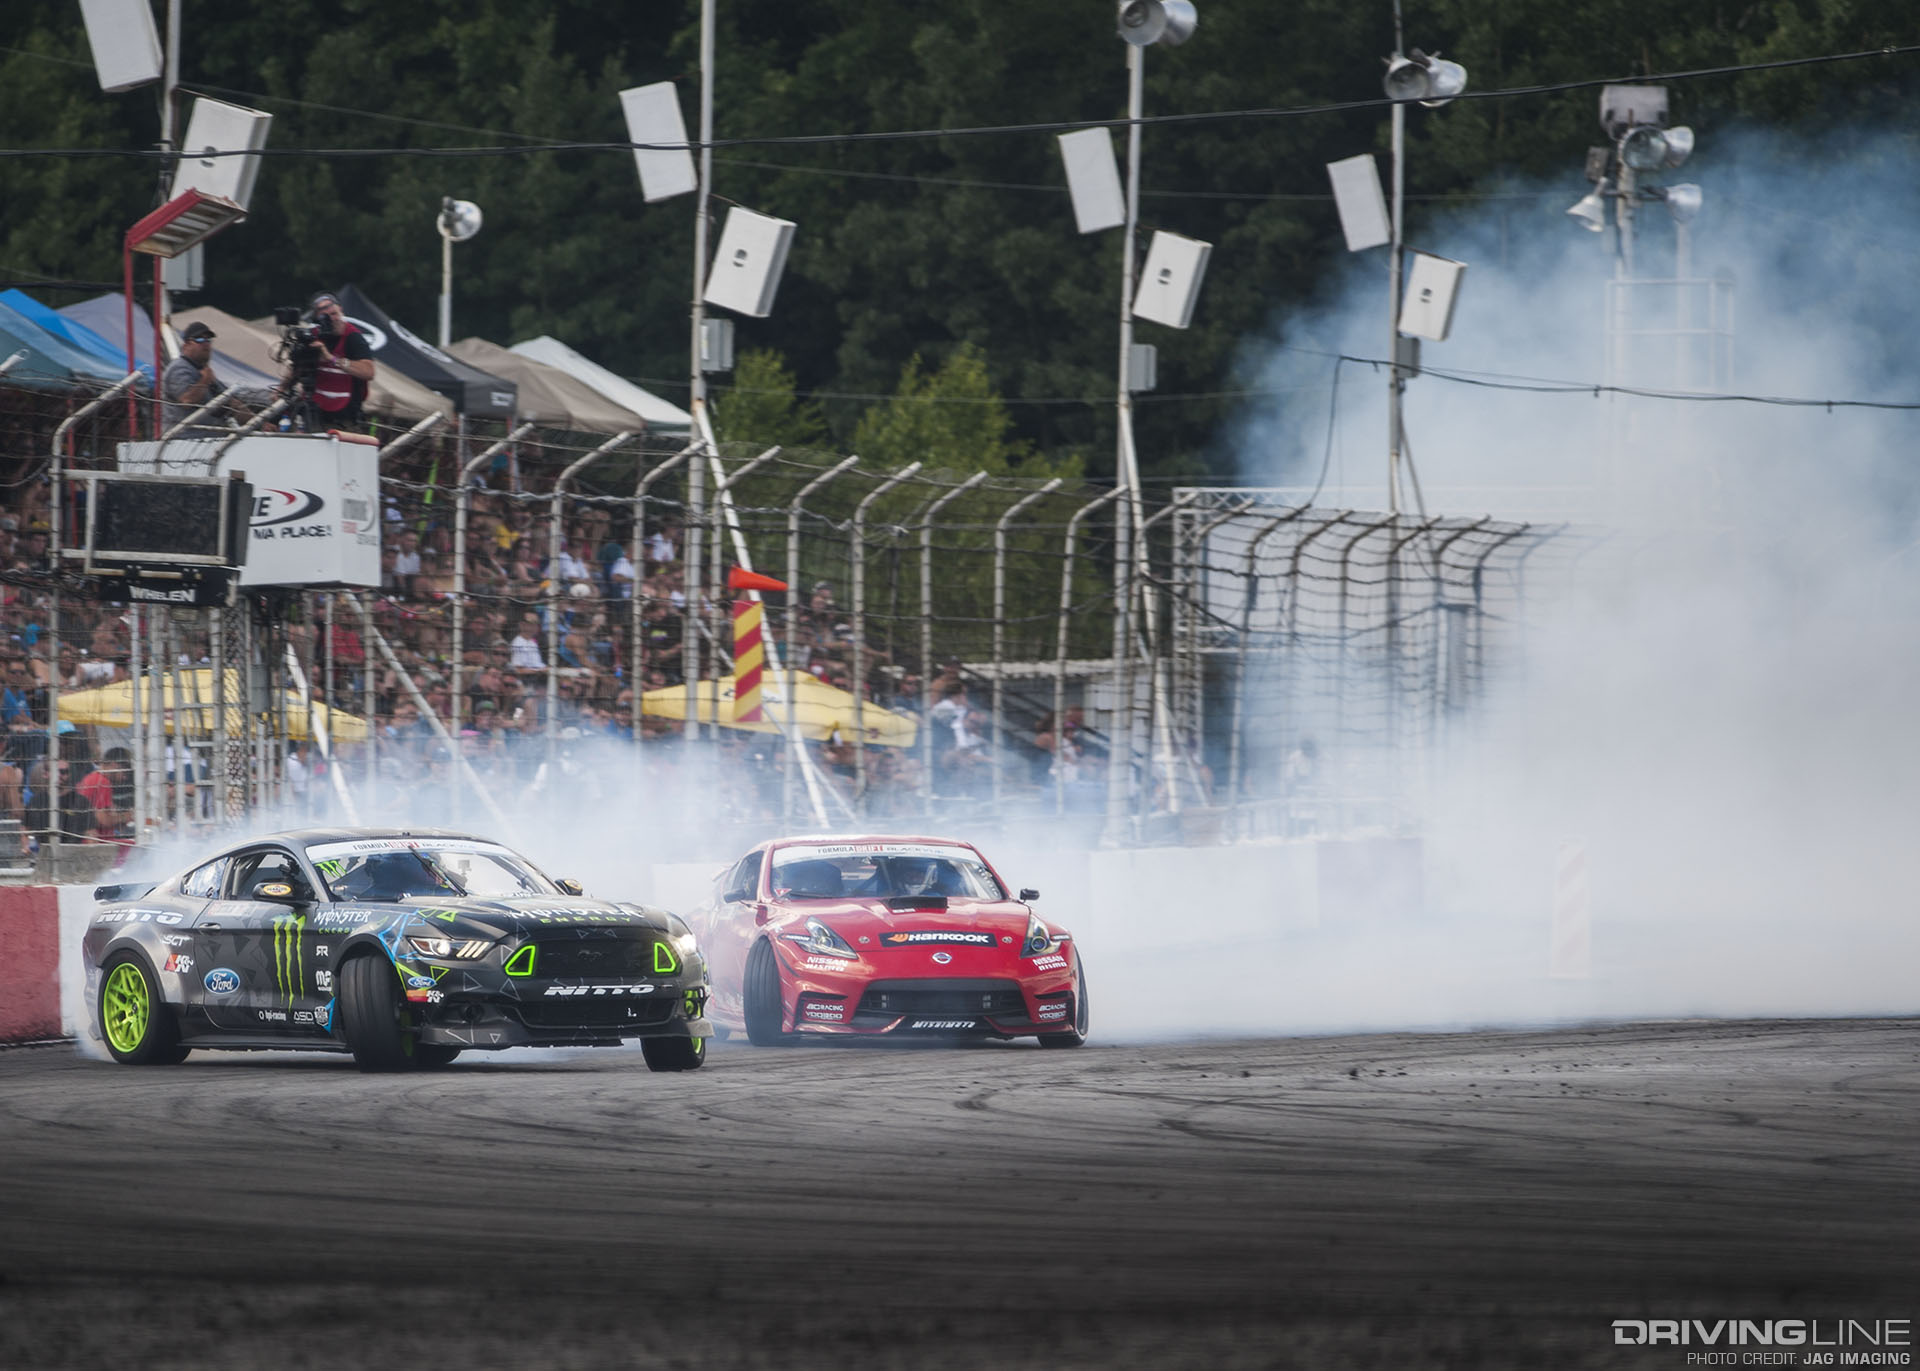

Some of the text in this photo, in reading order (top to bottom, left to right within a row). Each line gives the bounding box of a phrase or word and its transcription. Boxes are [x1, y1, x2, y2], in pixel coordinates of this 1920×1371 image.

[96, 908, 184, 925] NITTO
[807, 956, 849, 967] NISSAN
[1032, 955, 1065, 966] NISSAN
[211, 972, 233, 990] Ford
[544, 984, 655, 996] NITTO
